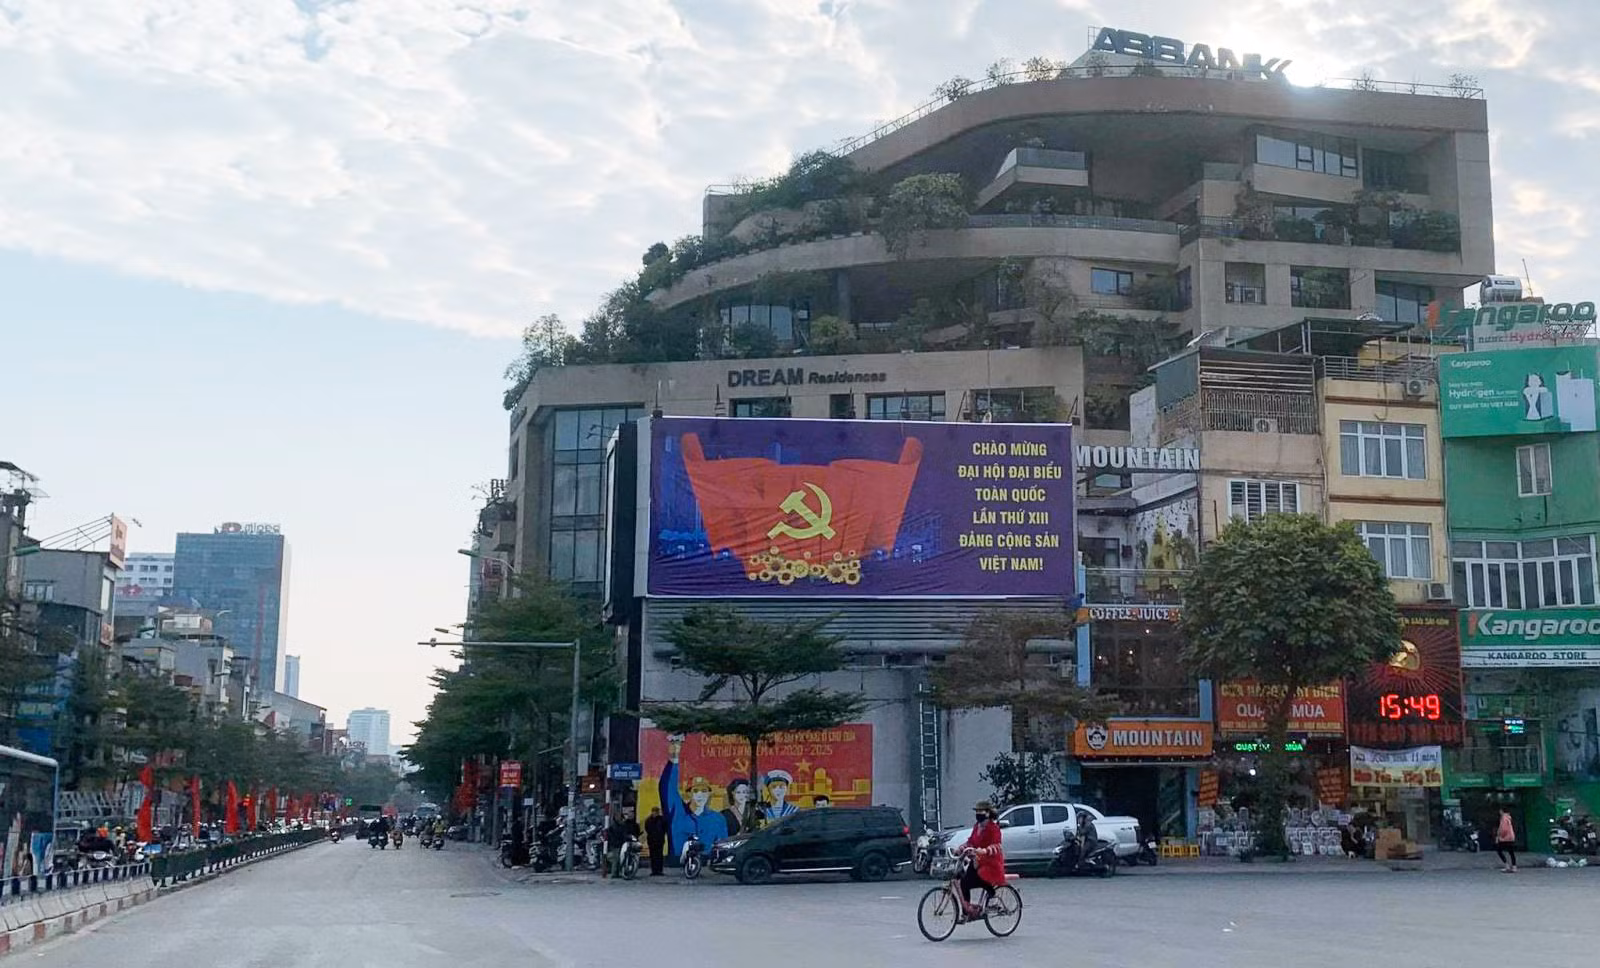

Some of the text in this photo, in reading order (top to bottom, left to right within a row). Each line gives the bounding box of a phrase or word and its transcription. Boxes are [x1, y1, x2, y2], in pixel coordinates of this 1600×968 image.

[1091, 27, 1292, 80] ABBANK
[728, 368, 887, 387] DREAM Residences
[972, 439, 1048, 456] CHÀO MỪNG
[1076, 446, 1200, 470] MOUNTAIN
[958, 461, 1062, 481] ĐẠI HỘI ĐẠI BIỂU
[975, 485, 1046, 502] TOÀN QUỐC
[973, 507, 1049, 524] LẦN THỨ XIII
[959, 531, 1059, 550] ĐẢNG CỘNG SẢN
[979, 554, 1044, 574] VIỆT NAM!
[1089, 607, 1169, 620] COFFEE JUICE
[1477, 612, 1600, 640] Kangaroo
[1487, 651, 1588, 661] KANGAROO STORE
[1292, 701, 1325, 718] MÙA
[1380, 694, 1440, 719] 15:49
[1113, 730, 1203, 746] MOUNTAIN
